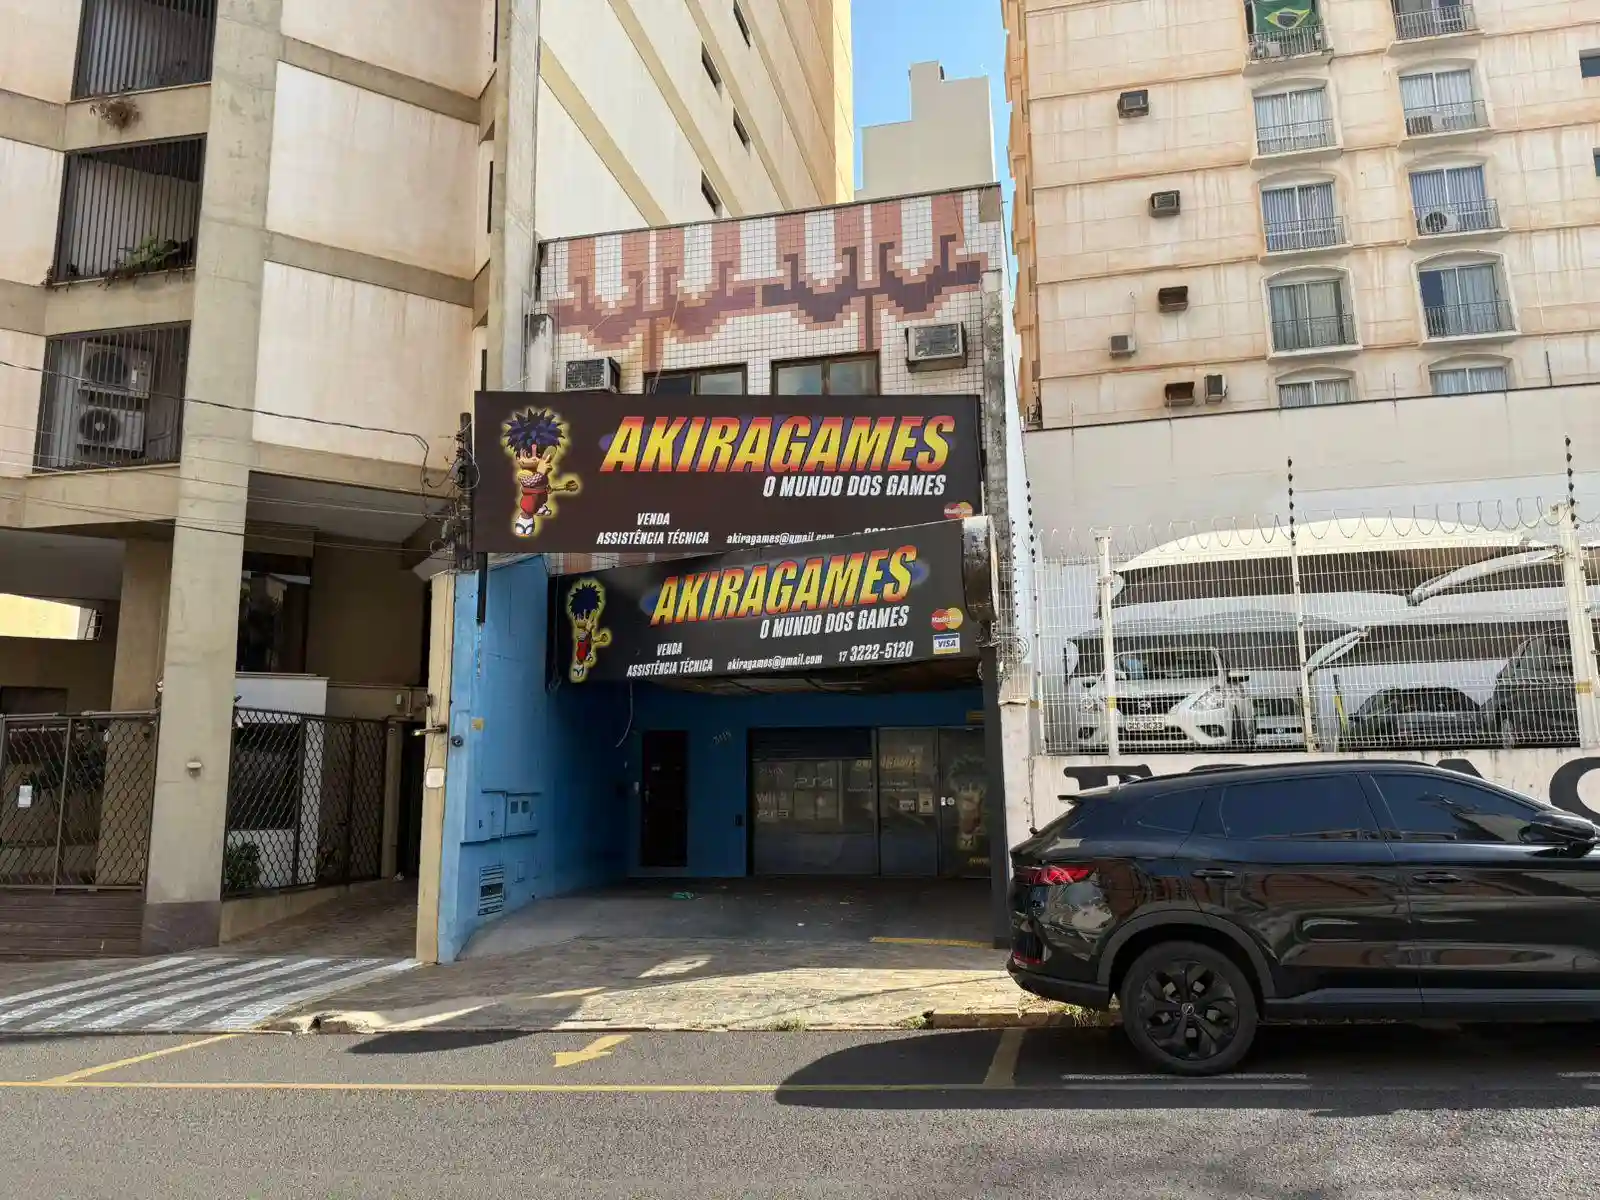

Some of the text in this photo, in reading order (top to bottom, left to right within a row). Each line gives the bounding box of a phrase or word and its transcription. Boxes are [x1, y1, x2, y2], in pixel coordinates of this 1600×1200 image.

[599, 414, 956, 474] AKIRAGAMES
[762, 474, 947, 498] O MUNDO DOS GAMES
[637, 512, 671, 526] VENDA
[596, 528, 709, 545] ASSISTÊNCIA TÉCNICA
[650, 544, 919, 627] AKIRAGAMES
[759, 605, 910, 640] O MUNDO DOS GAMES
[656, 642, 683, 656] VENDA
[838, 640, 914, 663] 17 3222-5120
[937, 639, 957, 648] VISA
[626, 657, 714, 677] ASSISTÊNCIA TÉCNICA
[727, 653, 823, 671] akiragames@gmail.com
